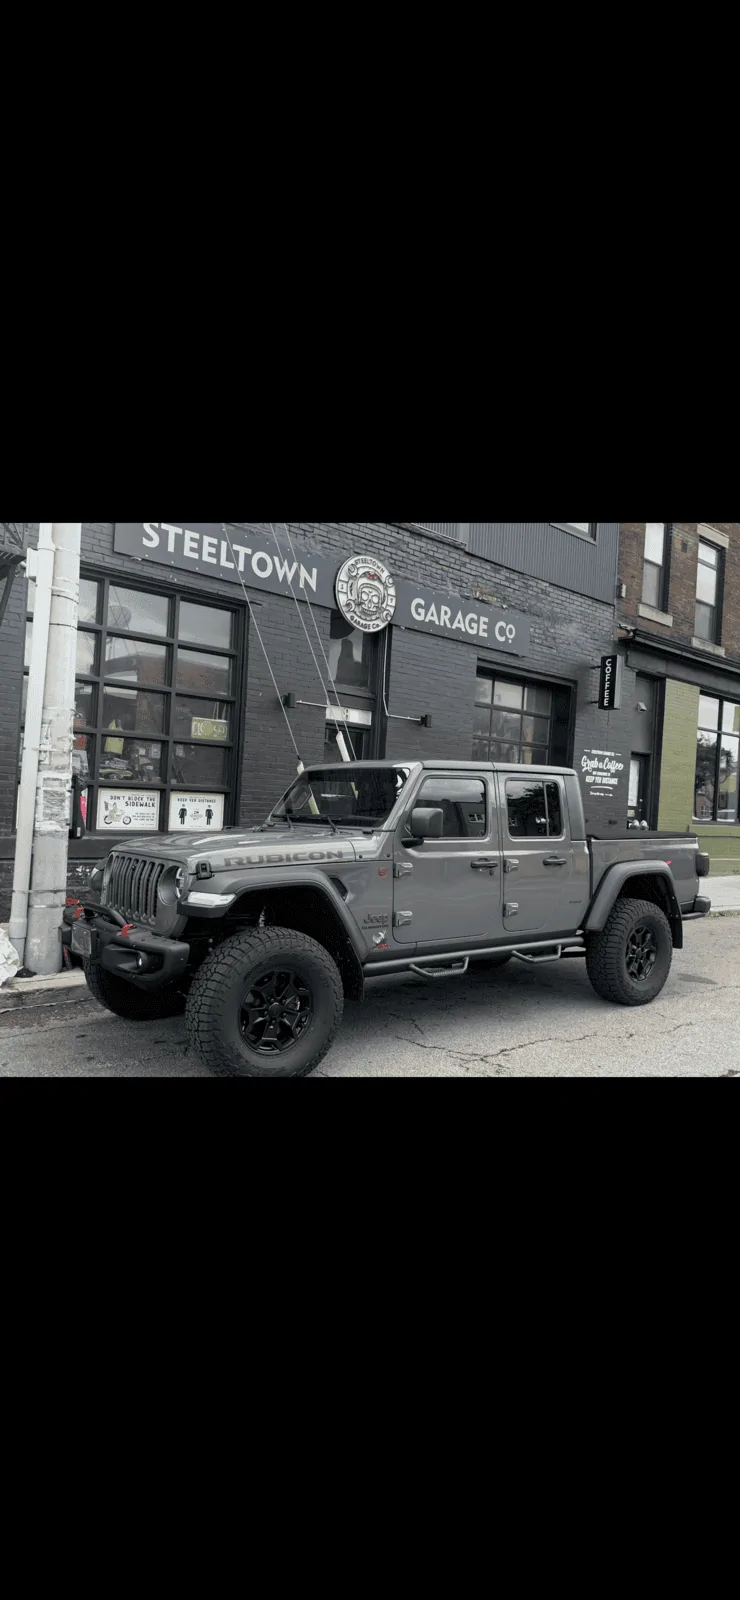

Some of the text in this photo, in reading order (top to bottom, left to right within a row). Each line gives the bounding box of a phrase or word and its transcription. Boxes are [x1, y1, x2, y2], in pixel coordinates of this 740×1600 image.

[141, 523, 318, 593] STEELTOWN
[354, 557, 386, 574] STEELTOWN
[349, 615, 371, 630] GARAGE
[410, 597, 489, 638] GARAGE
[603, 658, 612, 706] COFFEE
[581, 755, 598, 773] Grab
[603, 757, 624, 773] Coffee
[224, 850, 344, 867] RUBICON
[363, 913, 389, 925] Jeep
